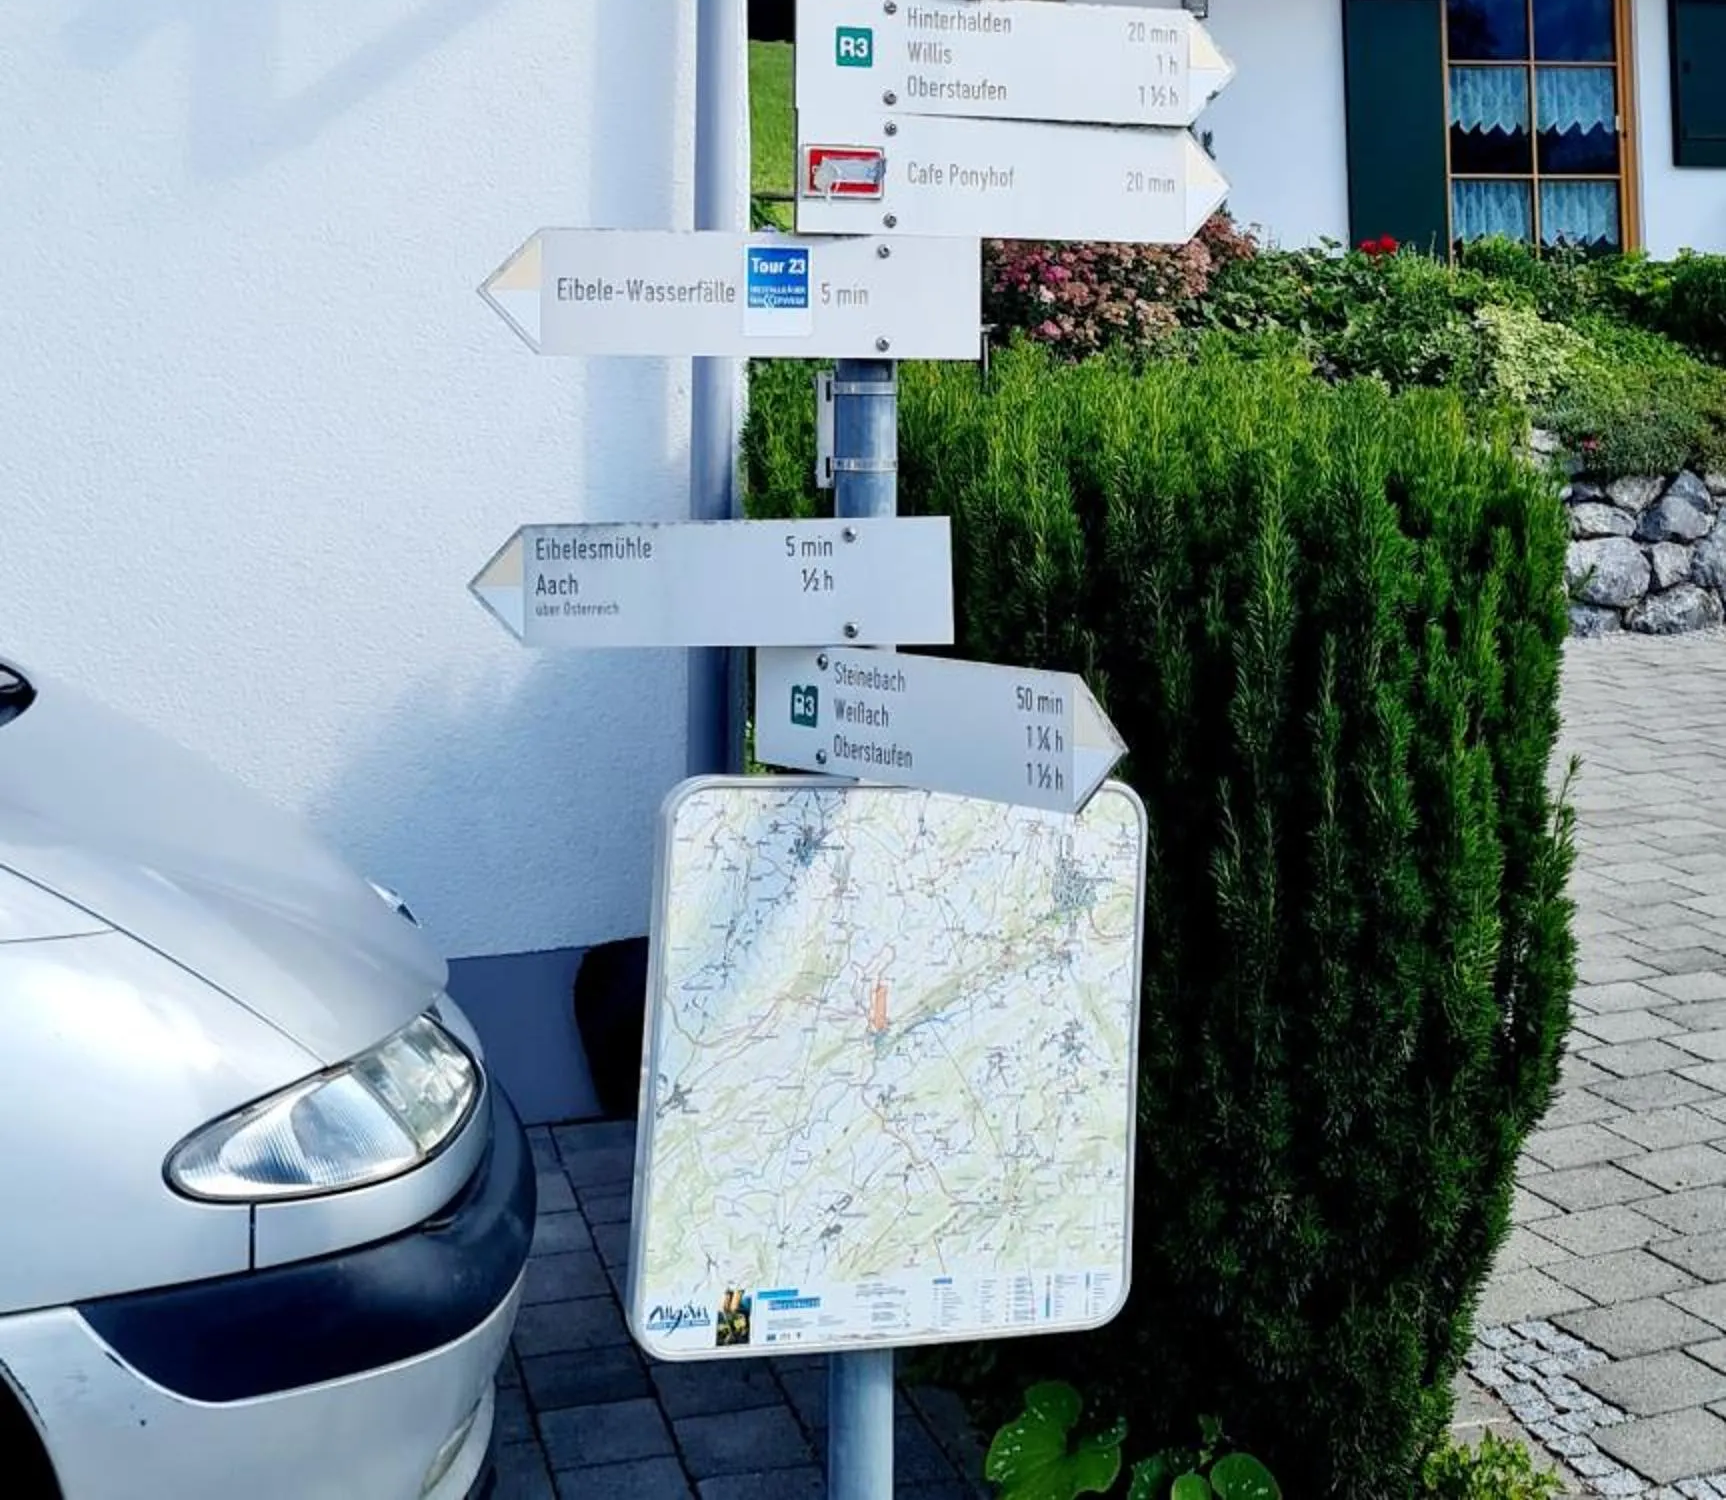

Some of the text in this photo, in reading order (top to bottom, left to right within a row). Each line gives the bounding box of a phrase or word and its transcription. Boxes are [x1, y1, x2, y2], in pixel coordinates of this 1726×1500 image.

[907, 6, 1178, 44] Hinterhalden 20 min
[840, 36, 868, 58] R3
[907, 41, 1178, 76] Willis 1 h
[907, 75, 1008, 100] Oberstaufen
[1169, 85, 1179, 107] h
[907, 161, 1175, 193] Cafe Ponyhof 20 min
[751, 257, 806, 275] Tour 23
[557, 277, 736, 303] Eibele-Wasserfälle
[821, 283, 831, 306] 5
[837, 284, 868, 306] min
[535, 535, 833, 560] Eibelesmühle 5 min
[535, 573, 579, 596] Aach
[823, 569, 833, 591] h
[834, 661, 1063, 714] Steinebach 50 min
[834, 699, 889, 728] Weißach
[1055, 729, 1063, 752] h
[833, 733, 913, 768] Oberstaufen
[1055, 766, 1063, 791] h
